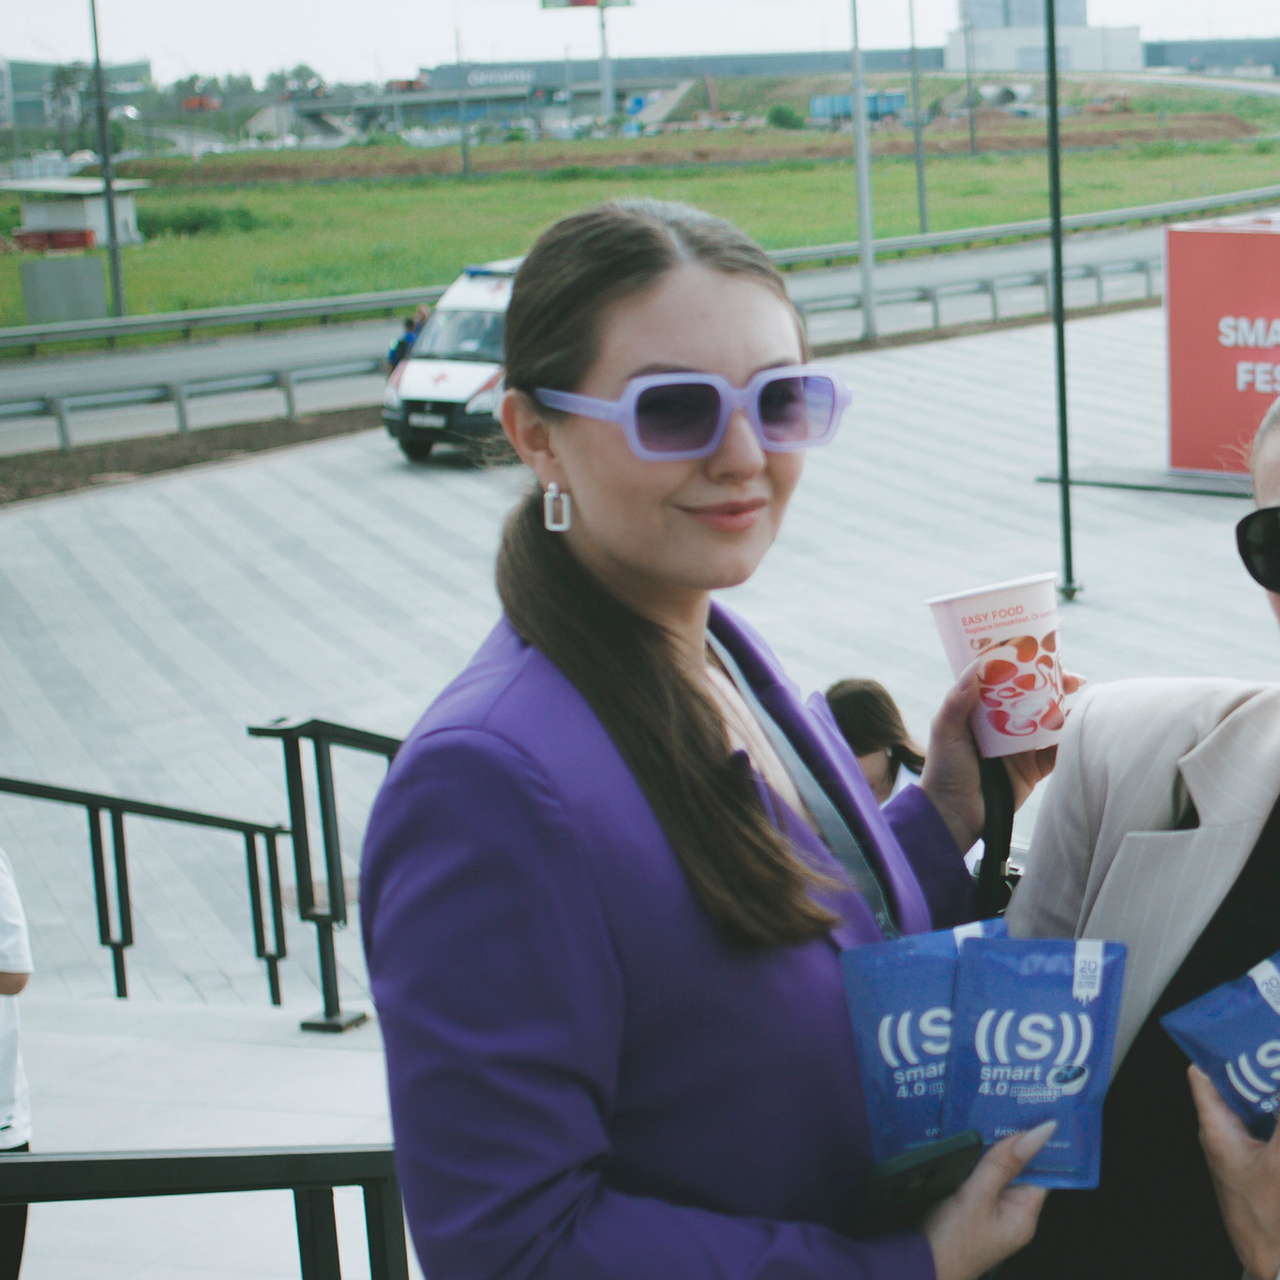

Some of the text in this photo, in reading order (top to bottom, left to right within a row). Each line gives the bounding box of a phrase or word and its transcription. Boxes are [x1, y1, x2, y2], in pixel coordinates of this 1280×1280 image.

[961, 605, 1025, 627] EASY FOOD
[1077, 959, 1098, 974] 20
[979, 1064, 1041, 1081] smart
[896, 1082, 926, 1099] 4.0
[978, 1082, 1008, 1096] 4.0
